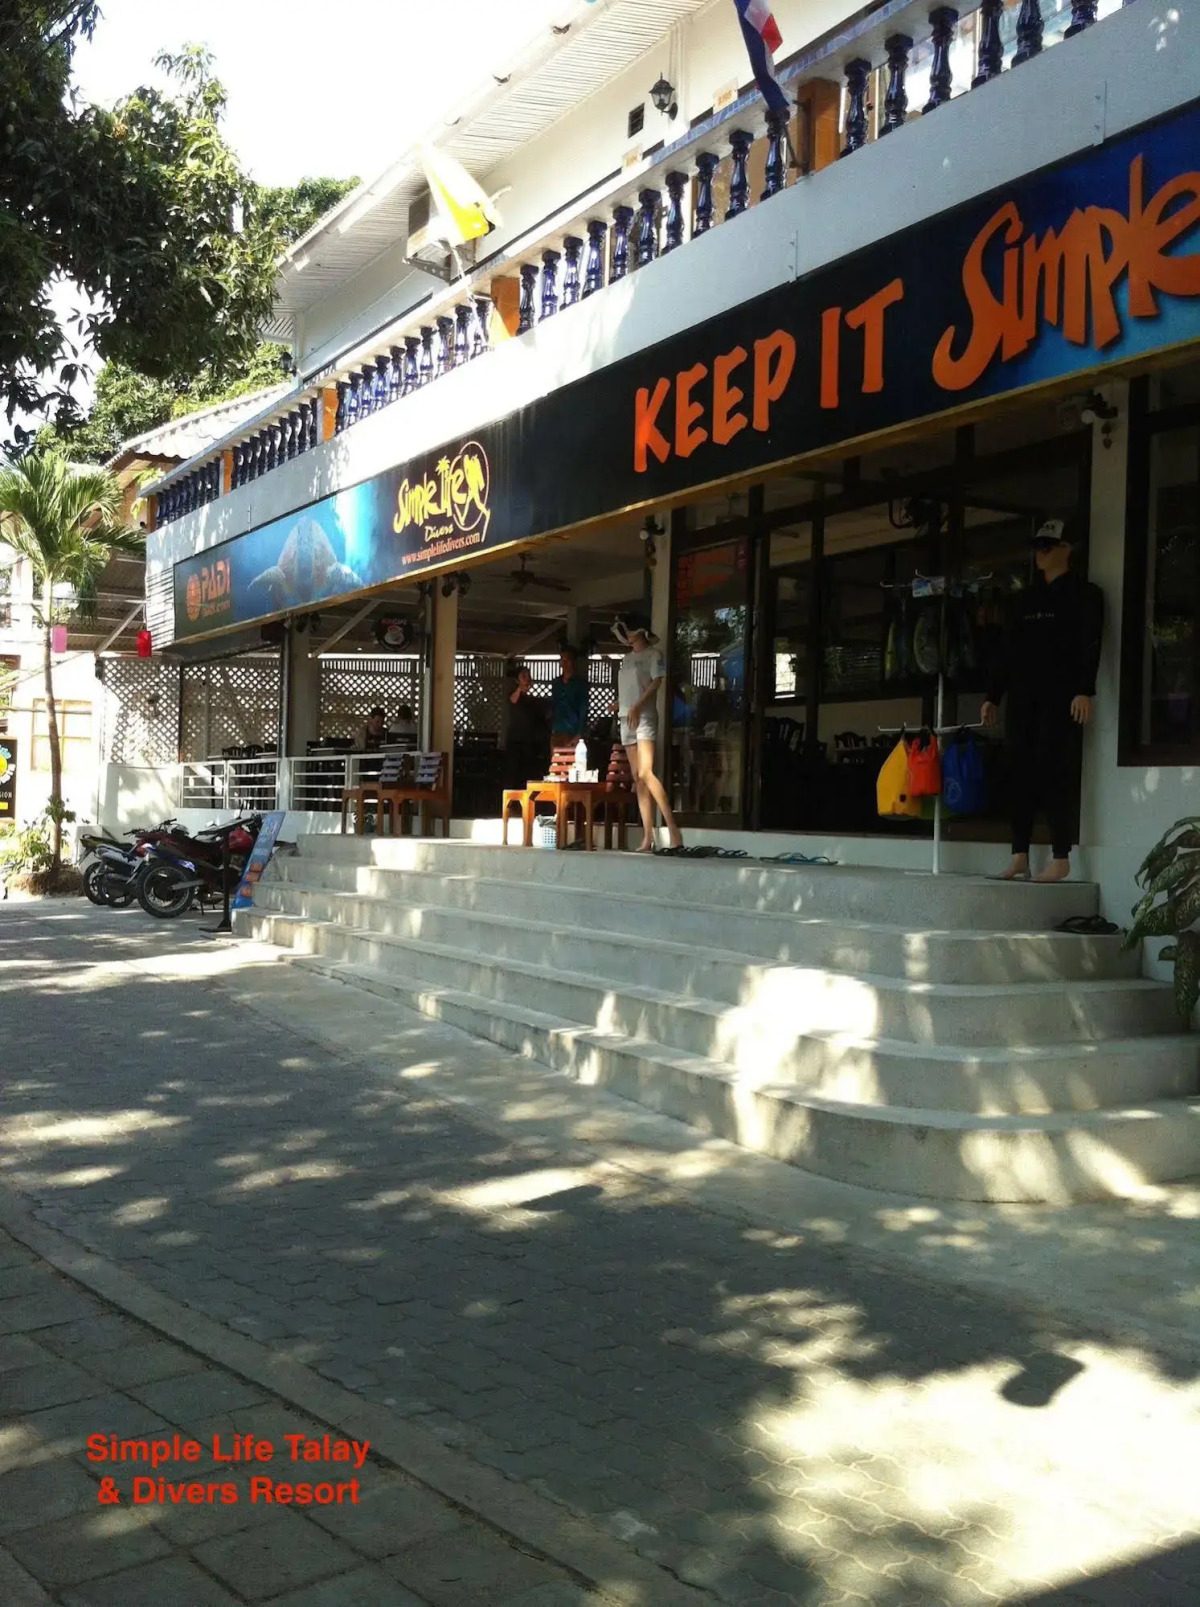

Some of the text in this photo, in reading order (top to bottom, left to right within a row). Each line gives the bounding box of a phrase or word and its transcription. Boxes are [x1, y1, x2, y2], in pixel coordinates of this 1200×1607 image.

[634, 153, 1200, 474] KEEP IT Simple
[393, 472, 441, 534] Simple
[402, 532, 480, 565] www.simplelifedivers.com
[202, 558, 230, 603] PADI
